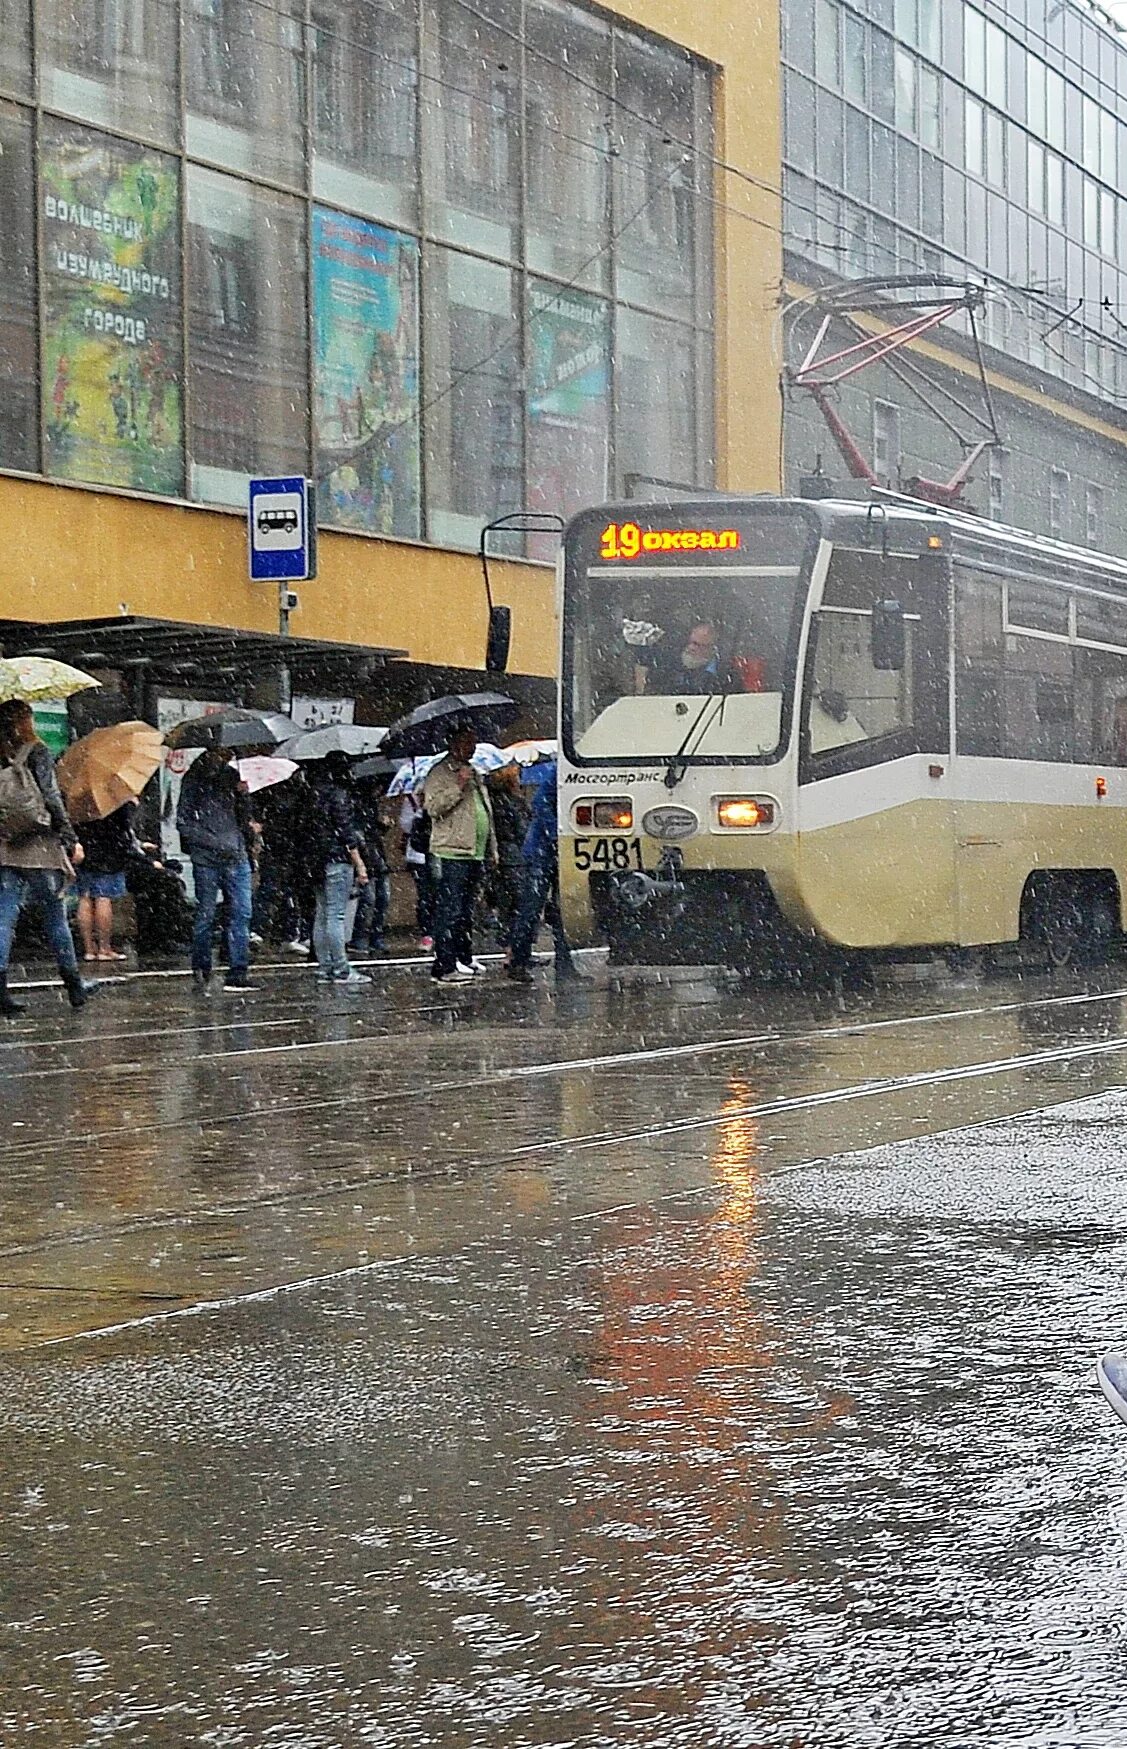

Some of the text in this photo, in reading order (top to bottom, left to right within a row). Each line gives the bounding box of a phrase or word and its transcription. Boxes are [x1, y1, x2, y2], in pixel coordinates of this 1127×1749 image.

[600, 523, 738, 558] 19 окзал
[574, 838, 643, 871] 5481
